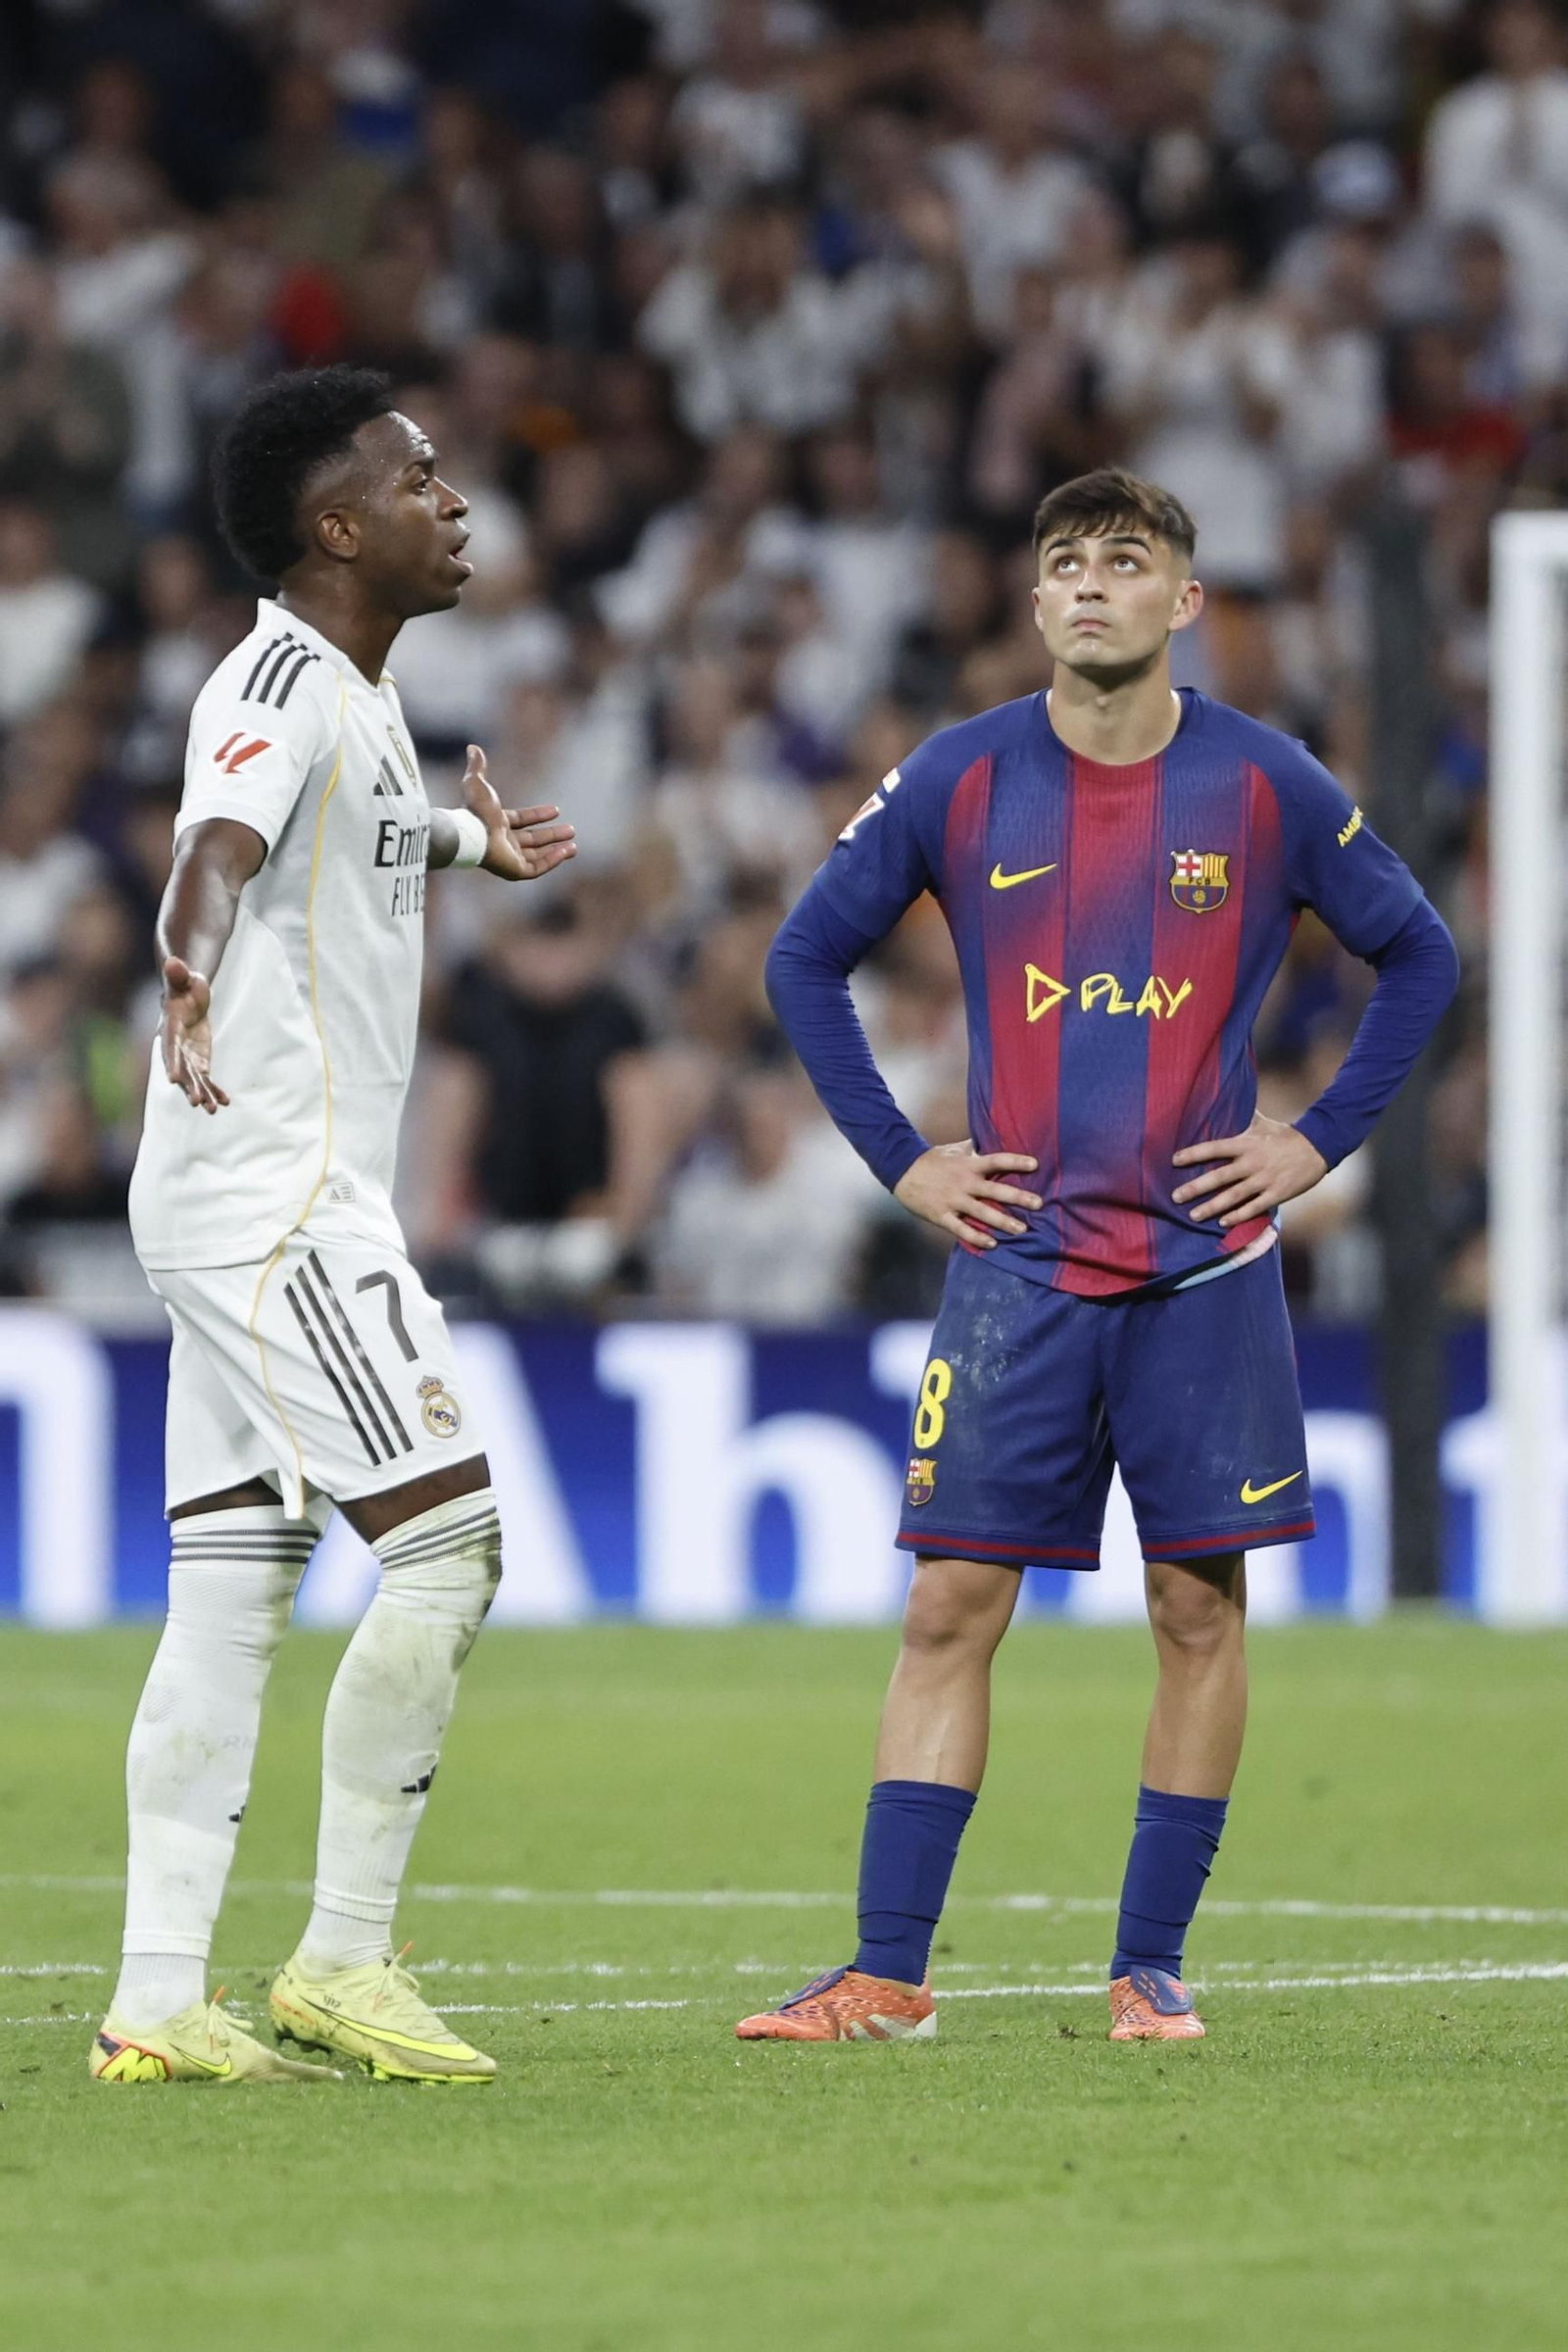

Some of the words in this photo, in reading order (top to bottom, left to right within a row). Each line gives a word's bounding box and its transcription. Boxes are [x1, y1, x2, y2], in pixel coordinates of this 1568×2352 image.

[1080, 972, 1193, 1020] PLAY
[355, 1269, 418, 1363] 7
[913, 1357, 953, 1450] 8
